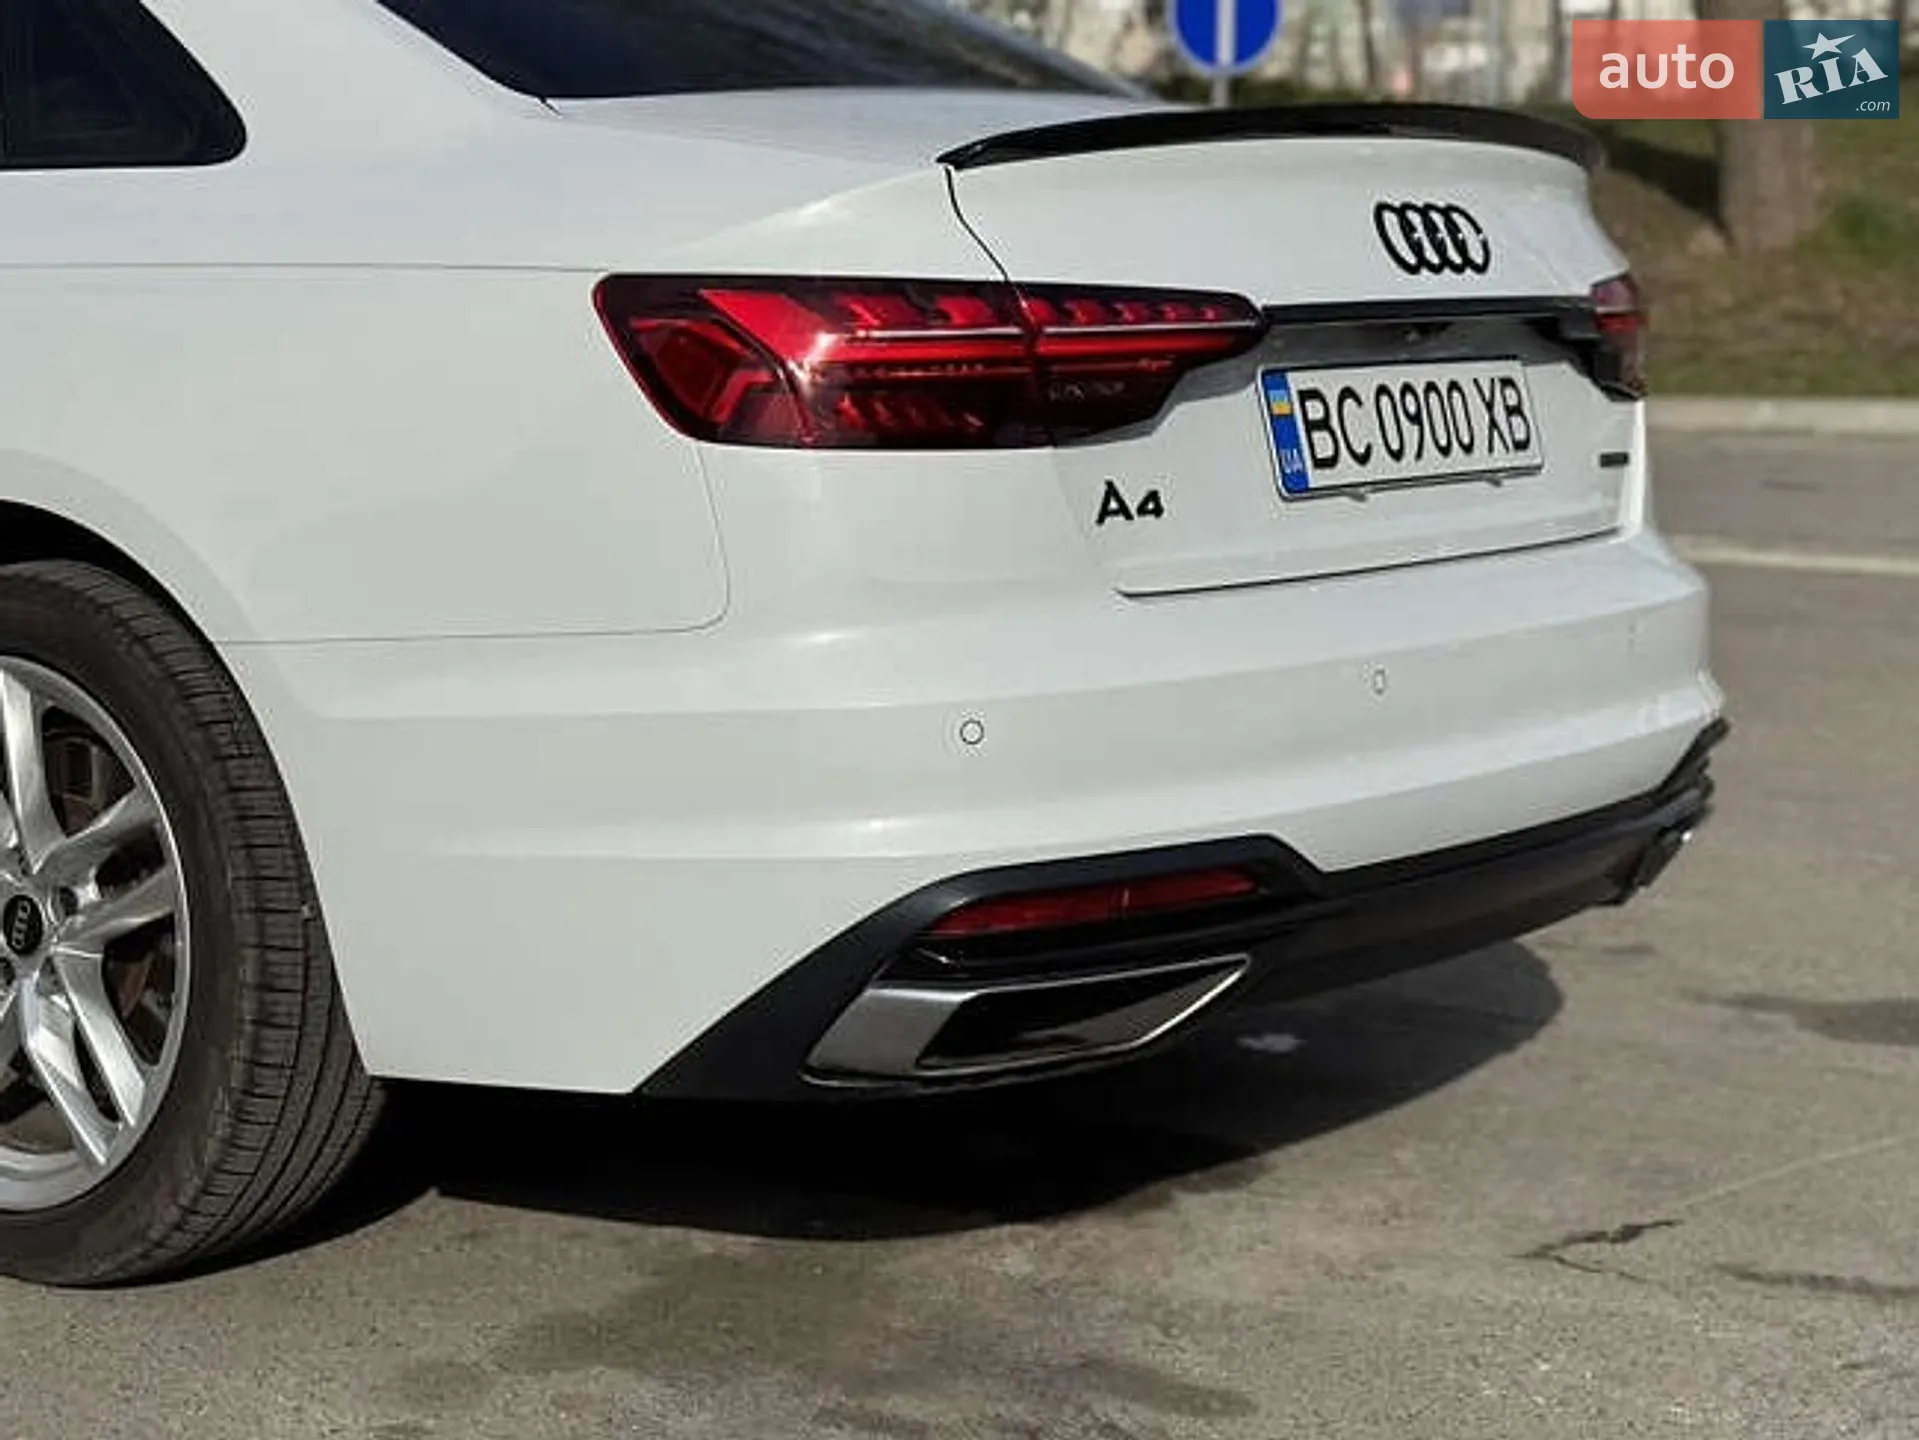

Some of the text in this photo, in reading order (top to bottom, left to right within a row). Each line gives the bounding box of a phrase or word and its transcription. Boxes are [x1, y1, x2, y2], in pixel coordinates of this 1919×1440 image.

[1298, 377, 1531, 468] BC 0900 XB
[1095, 480, 1164, 526] A4
